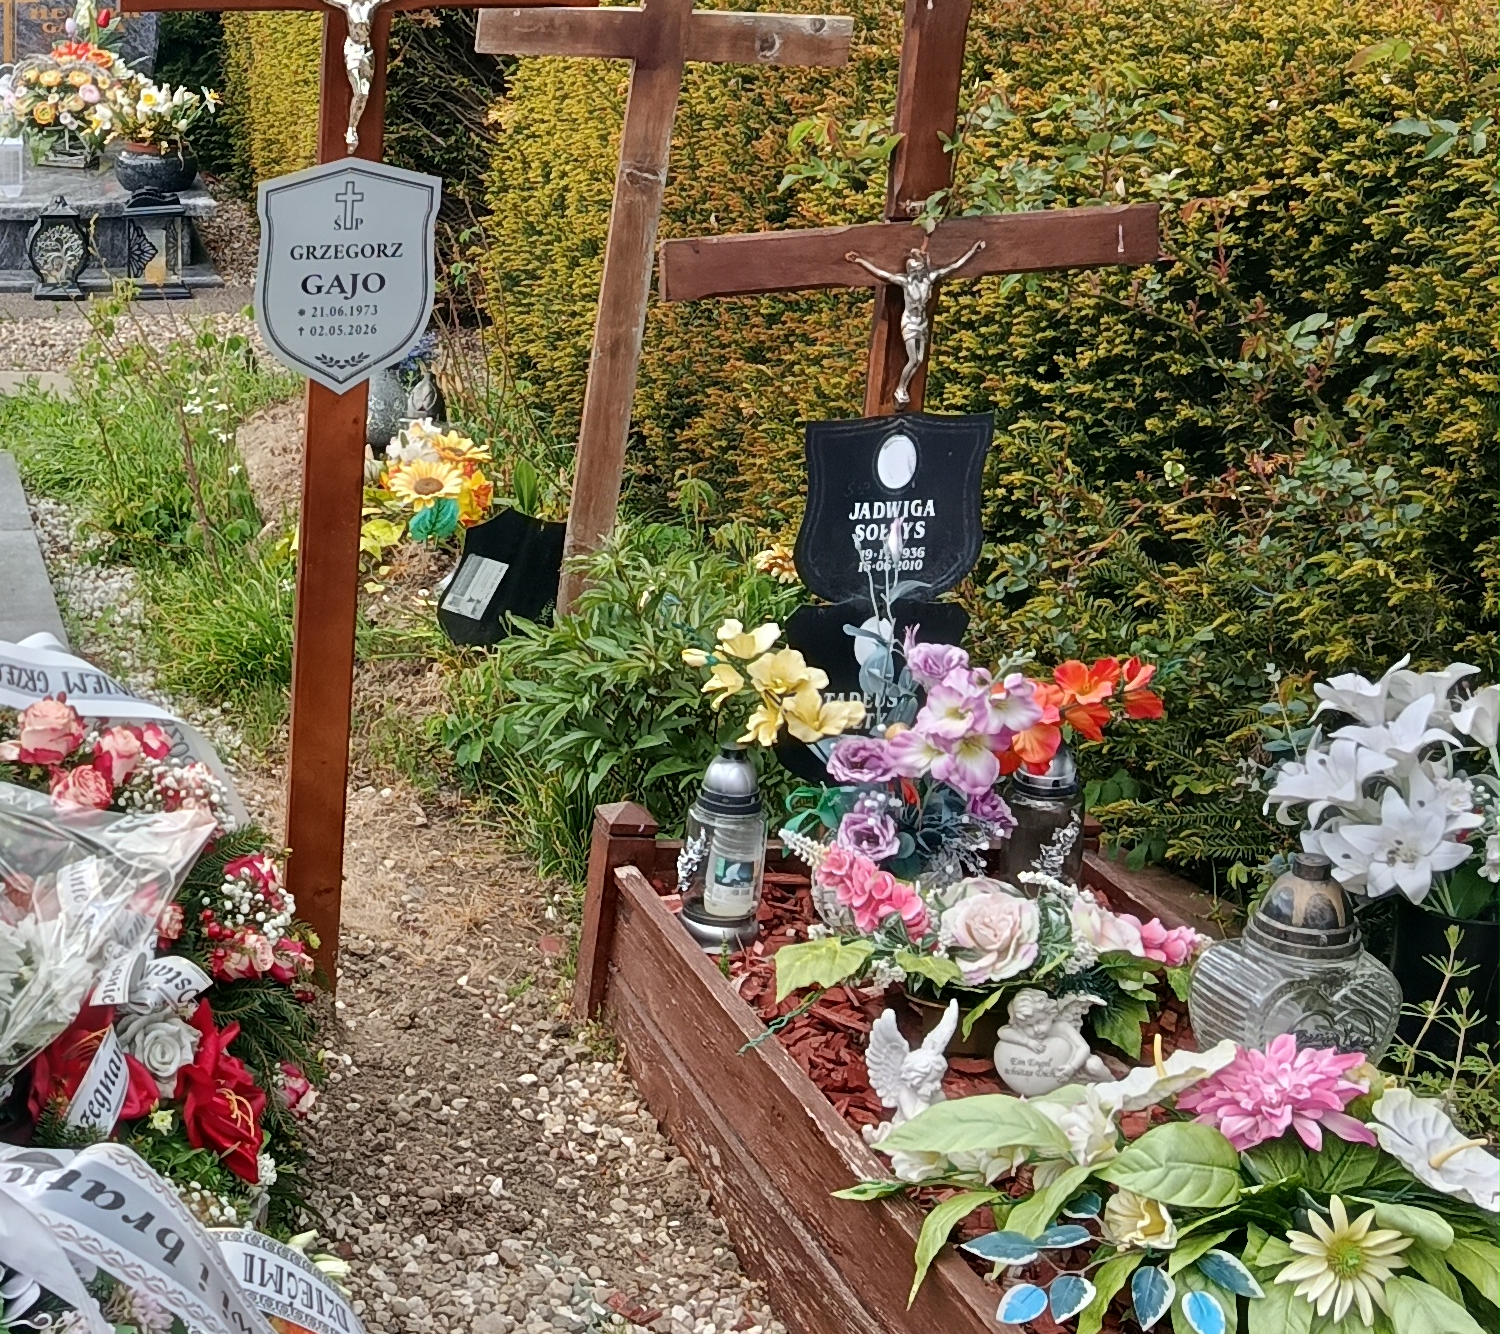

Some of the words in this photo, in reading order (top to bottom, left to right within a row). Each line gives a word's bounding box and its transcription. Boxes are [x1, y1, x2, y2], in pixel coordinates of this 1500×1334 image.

[289, 242, 404, 261] GRZEGORZ
[301, 272, 387, 301] GAJO
[311, 304, 379, 318] 21.06.1973
[309, 324, 378, 336] 02.05.2026
[848, 499, 936, 521] JADWIGA
[854, 520, 926, 542] SOŁYS
